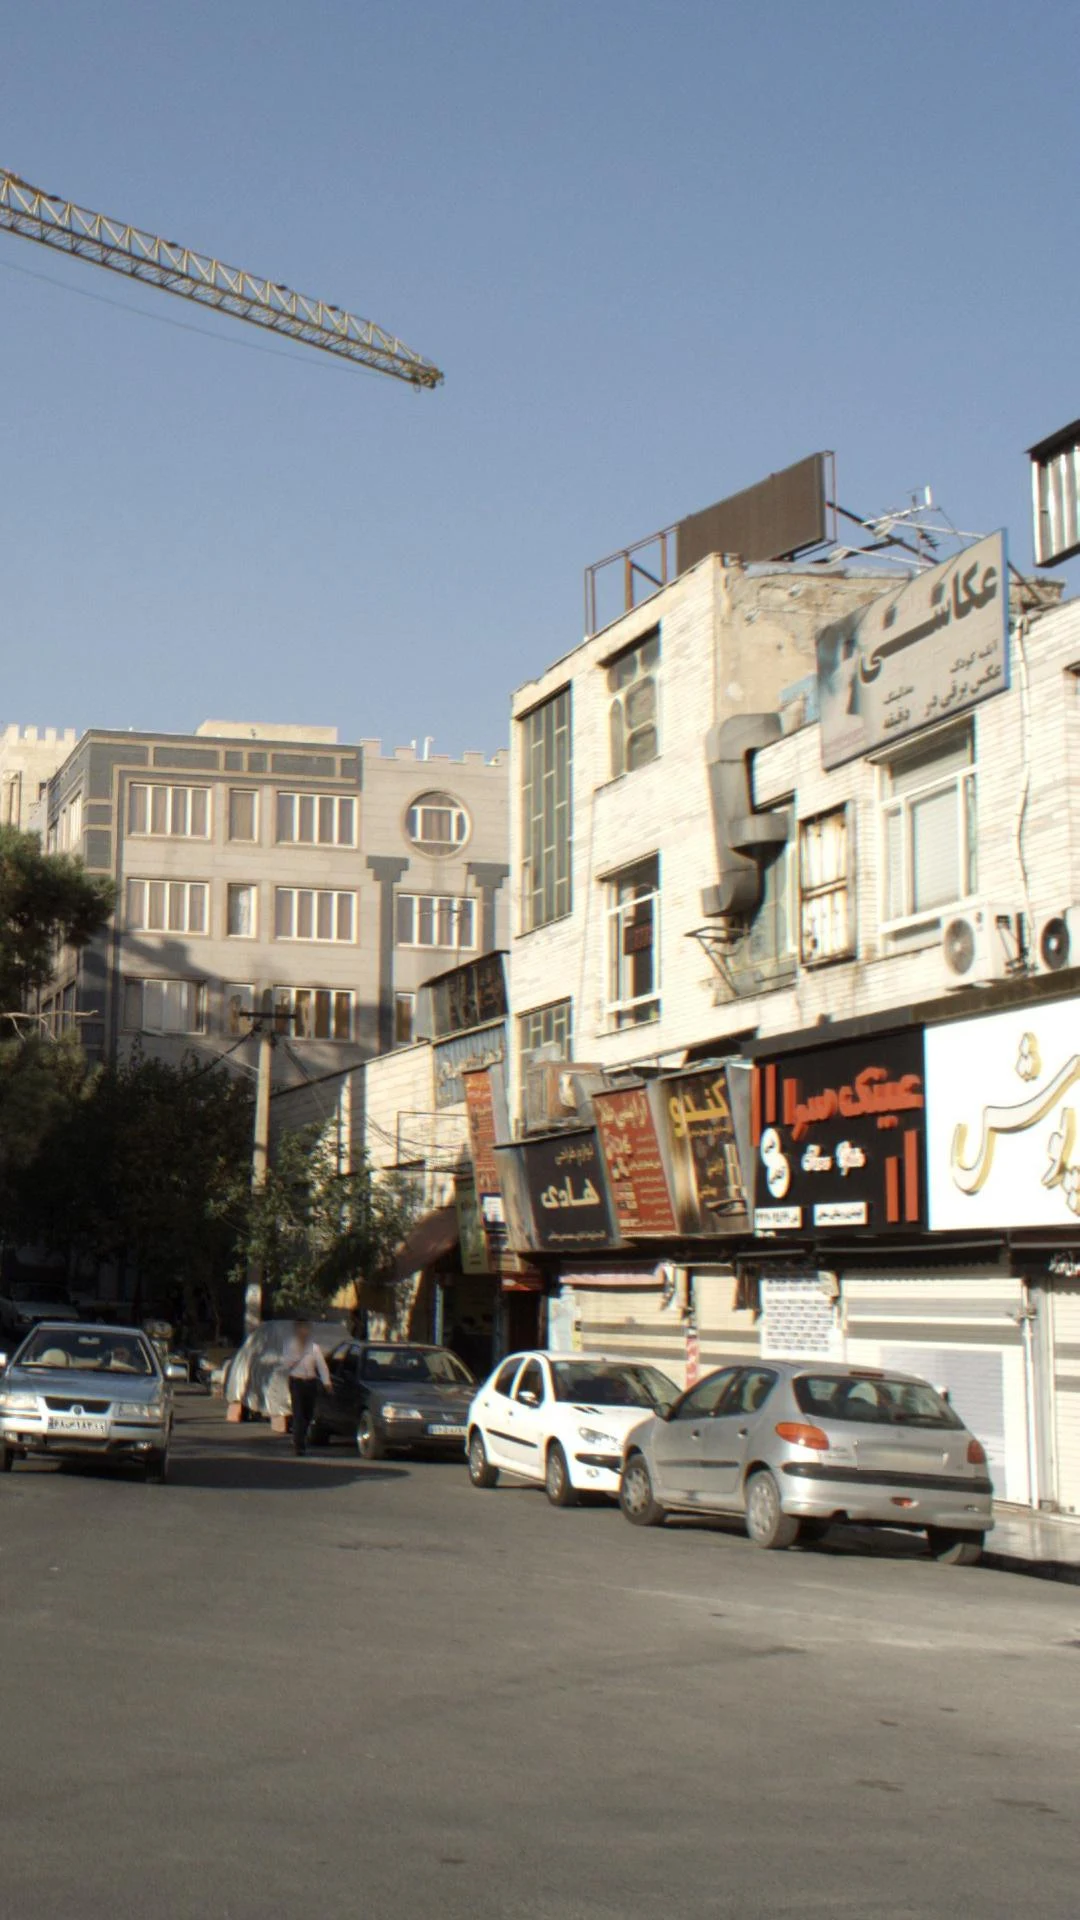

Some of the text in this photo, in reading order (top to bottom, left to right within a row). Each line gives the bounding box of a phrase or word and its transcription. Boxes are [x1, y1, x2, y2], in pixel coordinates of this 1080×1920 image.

[859, 560, 998, 685] عکاسی
[668, 1077, 730, 1138] کندو
[838, 1066, 923, 1130] عینک
[541, 1175, 602, 1210] هادی
